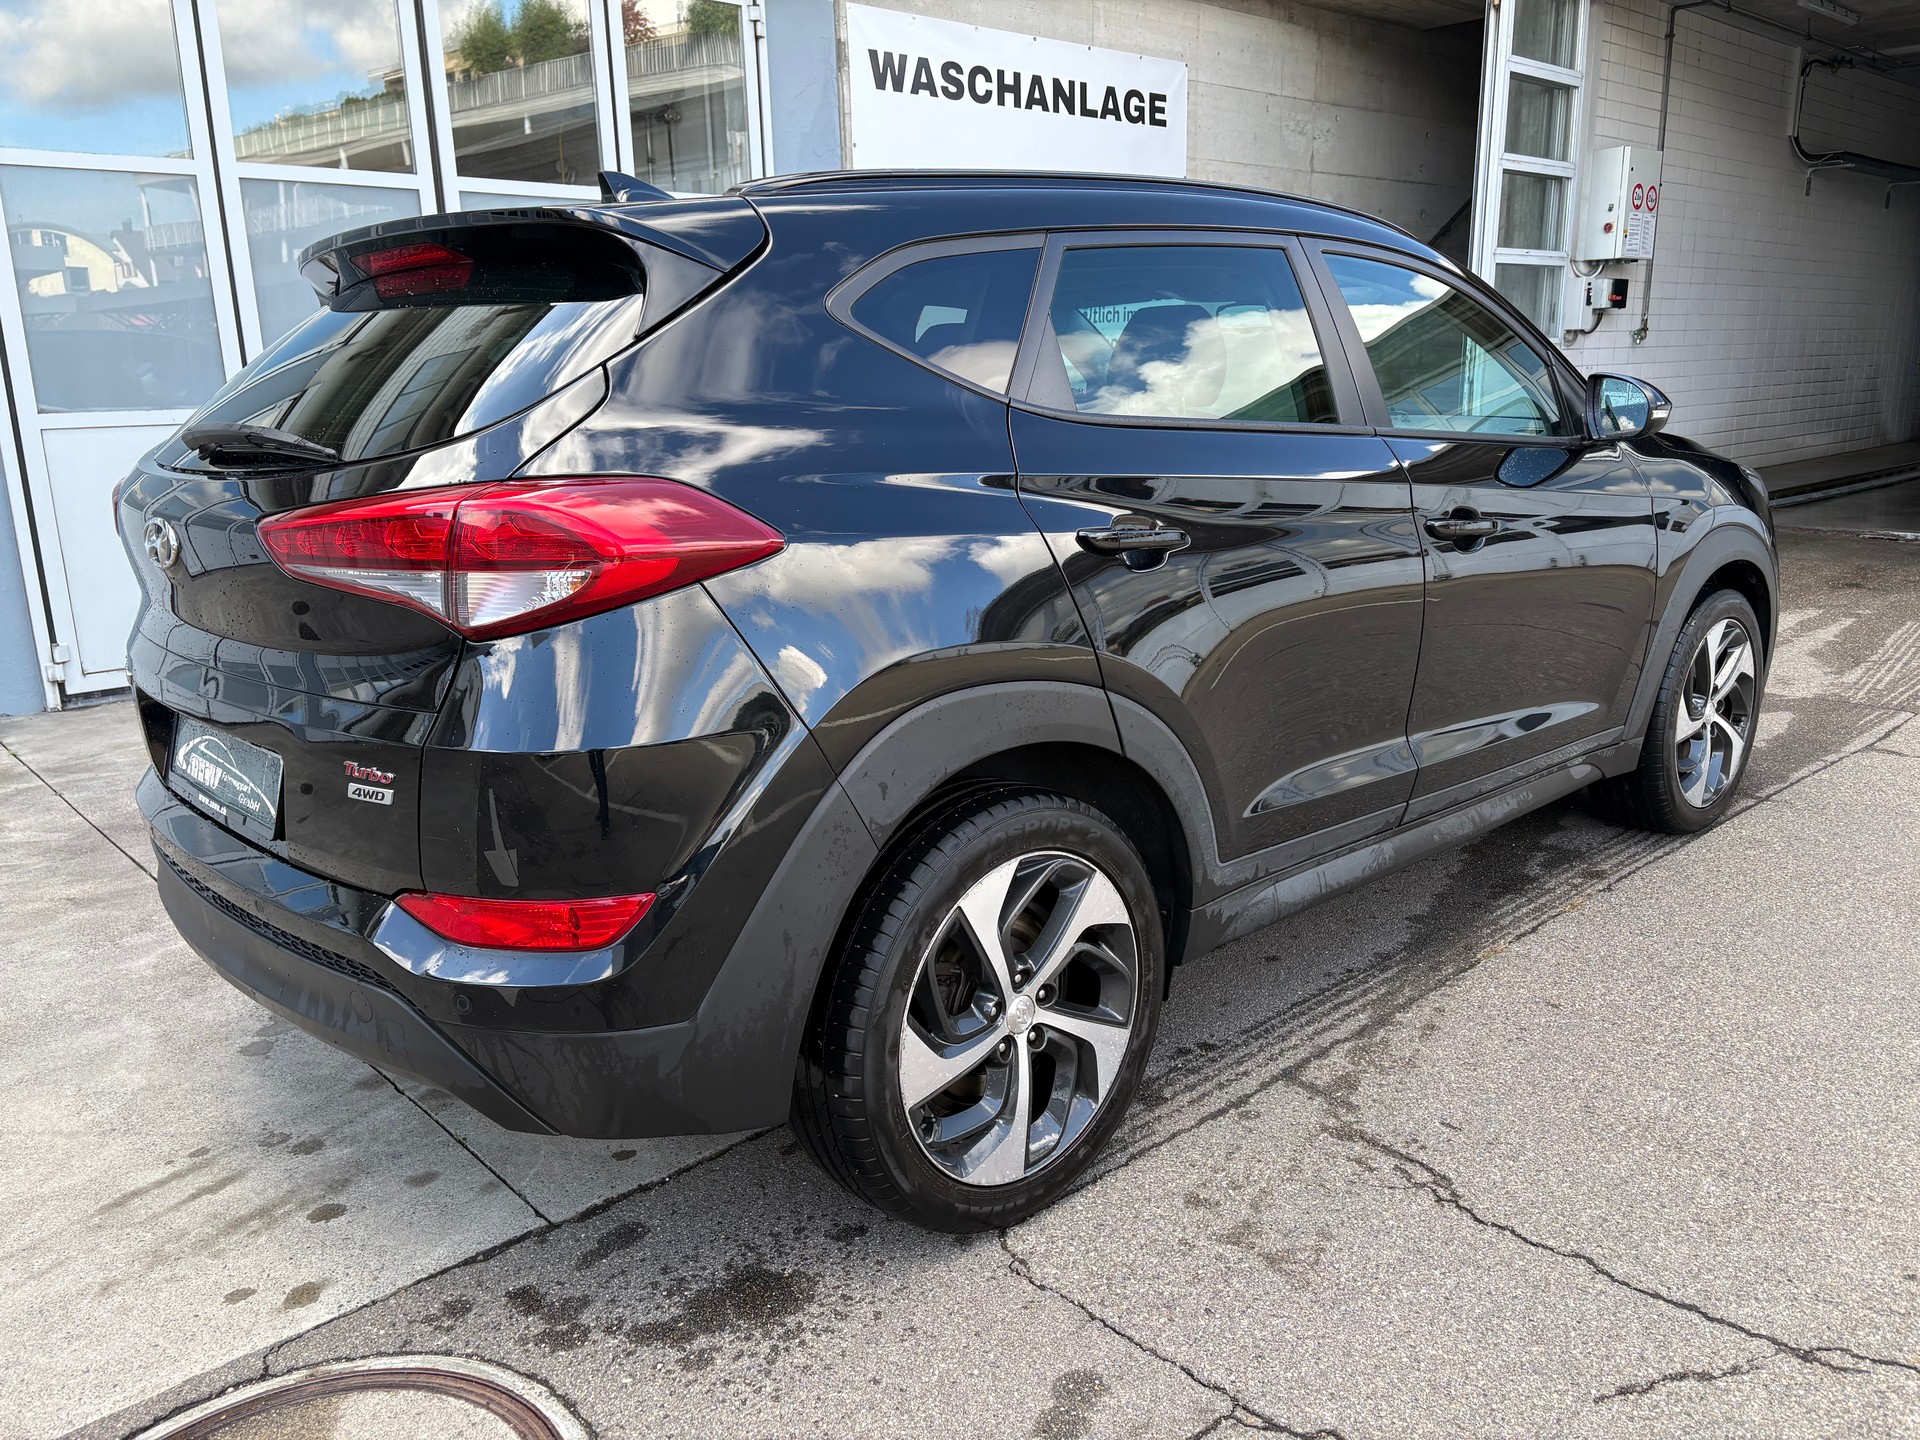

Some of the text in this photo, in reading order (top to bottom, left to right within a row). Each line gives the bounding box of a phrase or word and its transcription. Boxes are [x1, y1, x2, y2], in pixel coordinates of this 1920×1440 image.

[867, 48, 1168, 128] WASCHANLAGE
[342, 760, 396, 785] Turbo
[238, 792, 261, 813] GmbH
[351, 787, 386, 802] 4WD
